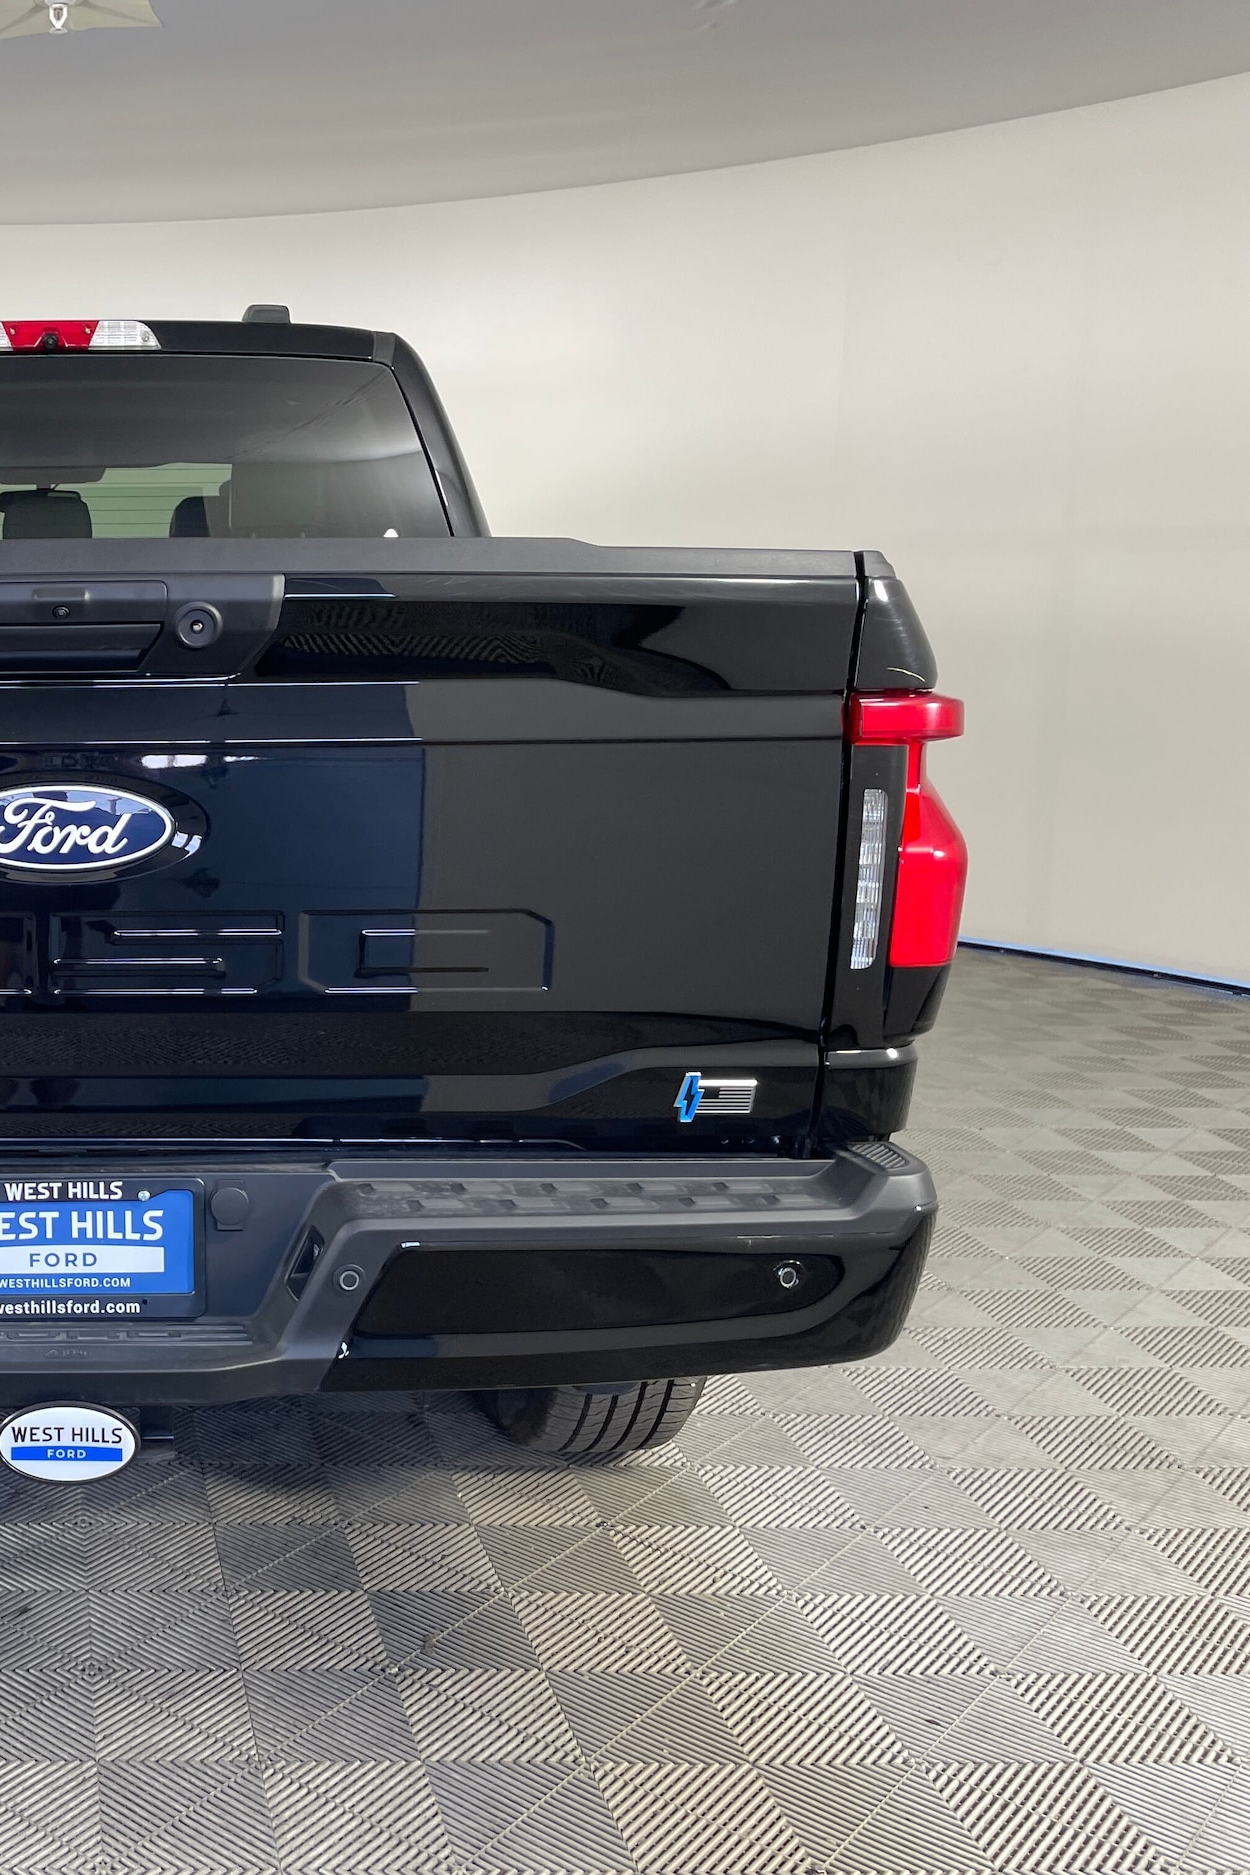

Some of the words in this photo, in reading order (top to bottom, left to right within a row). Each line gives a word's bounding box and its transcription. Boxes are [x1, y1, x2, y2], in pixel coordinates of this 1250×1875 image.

[3, 1182, 62, 1201] WEST
[67, 1181, 123, 1200] HILLS
[71, 1209, 164, 1241] HILLS
[29, 1252, 98, 1268] FORD
[11, 1426, 64, 1443] WEST
[71, 1427, 123, 1444] HILLS
[47, 1449, 87, 1459] FORD
